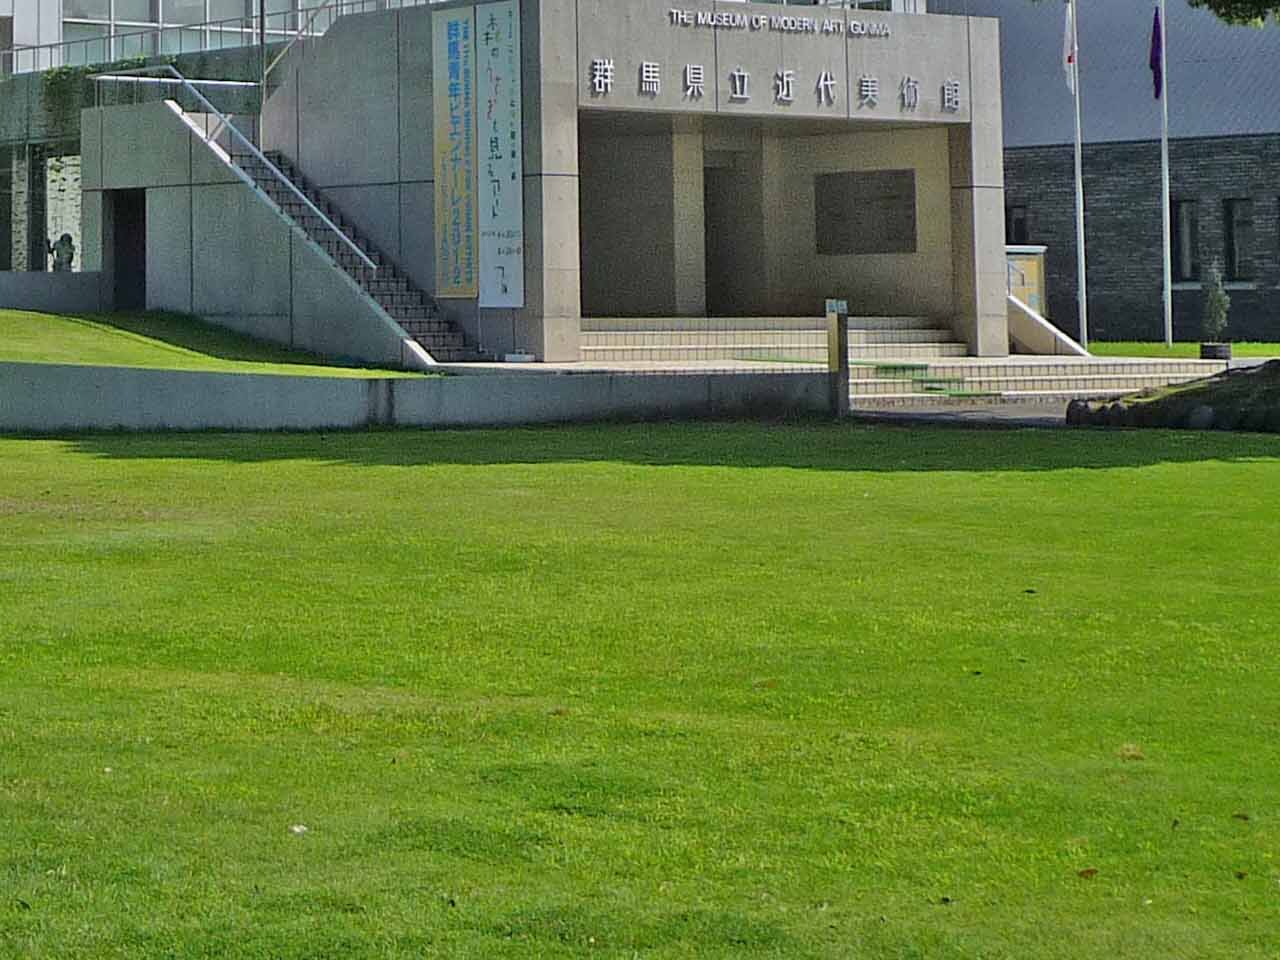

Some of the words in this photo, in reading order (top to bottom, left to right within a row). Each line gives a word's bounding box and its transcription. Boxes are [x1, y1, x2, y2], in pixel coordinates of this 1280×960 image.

[670, 8, 694, 25] THE
[697, 11, 748, 27] MUSEUM
[751, 15, 768, 29] OF
[770, 15, 818, 32] MODERN
[850, 20, 890, 36] GUNMA
[591, 58, 961, 111] 群馬県立近代美術館
